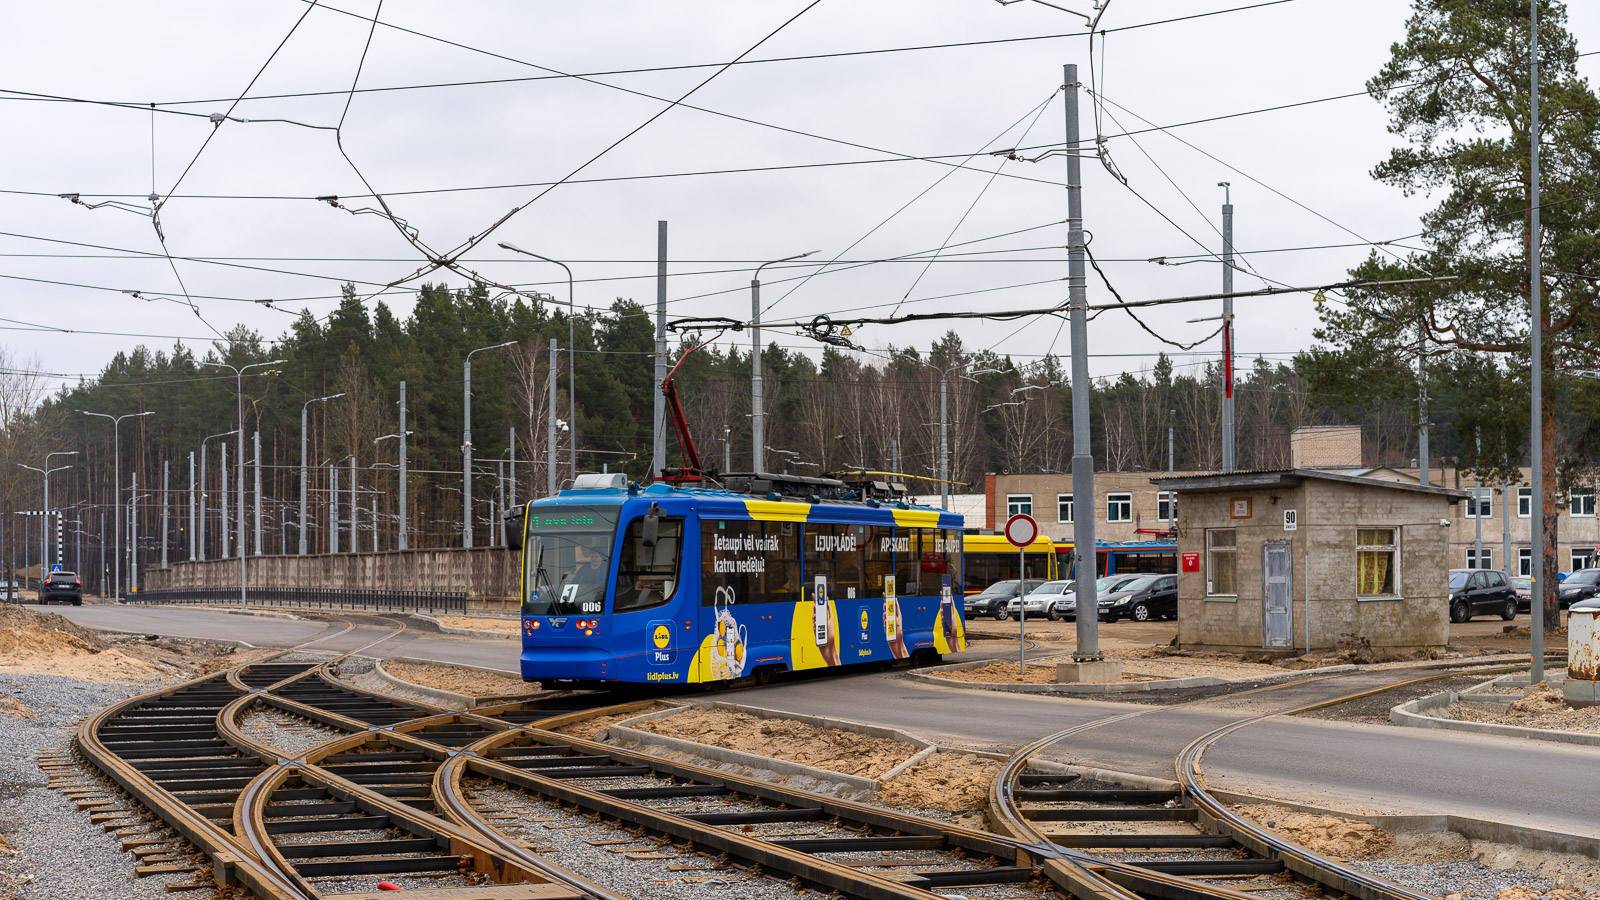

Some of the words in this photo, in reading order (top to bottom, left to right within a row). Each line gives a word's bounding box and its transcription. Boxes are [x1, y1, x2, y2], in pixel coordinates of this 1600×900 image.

[1285, 511, 1296, 524] 90
[713, 533, 743, 555] Ietaupi
[714, 556, 735, 573] katru
[582, 601, 601, 613] 006
[655, 651, 670, 662] Plus
[647, 671, 679, 682] lidlplus.lv
